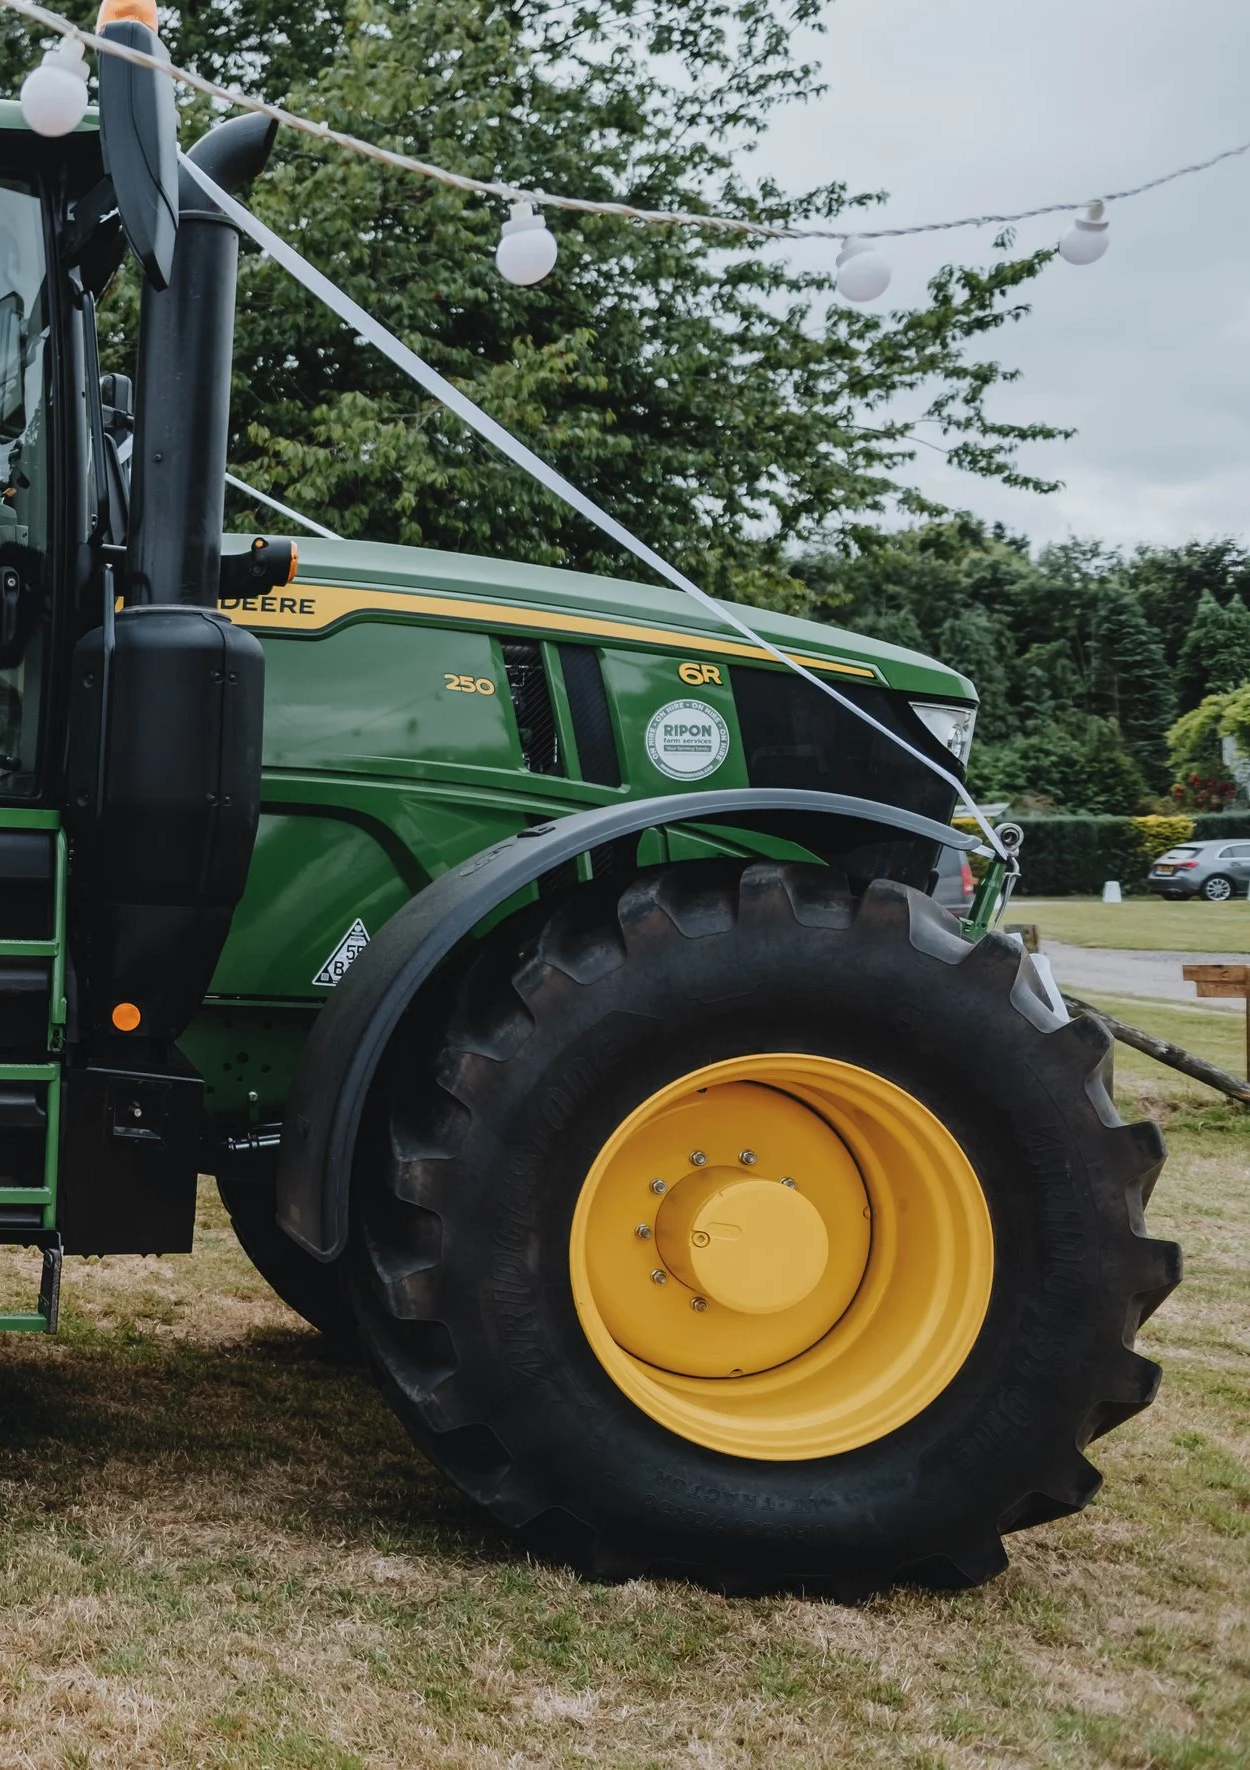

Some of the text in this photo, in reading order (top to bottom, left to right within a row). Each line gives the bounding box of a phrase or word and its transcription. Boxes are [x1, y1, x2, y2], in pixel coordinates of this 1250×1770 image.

[220, 597, 316, 615] DEERE
[444, 673, 496, 696] 250
[678, 662, 723, 686] 6R
[648, 702, 727, 761] ON HIRE ON HIRE ON HIRE ON HIRE
[663, 724, 712, 737] RIPON
